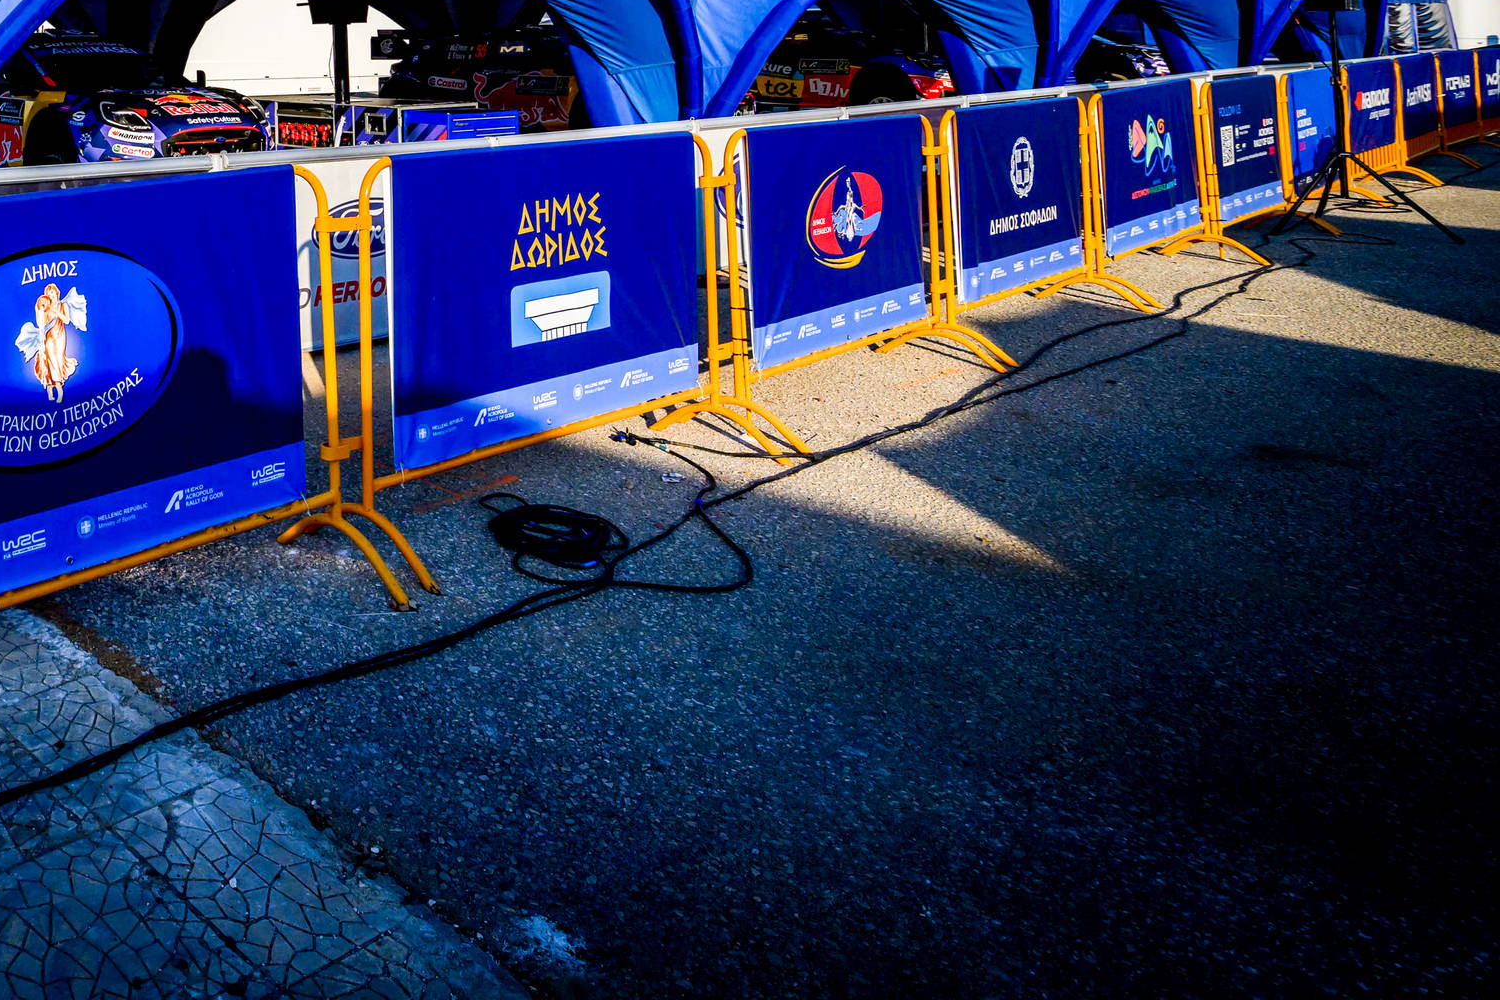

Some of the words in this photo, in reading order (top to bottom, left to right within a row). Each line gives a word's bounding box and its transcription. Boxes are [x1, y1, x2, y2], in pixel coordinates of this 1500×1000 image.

[436, 80, 466, 89] Castrol
[765, 81, 797, 98] tet
[161, 104, 203, 116] Red
[203, 102, 240, 114] Bull
[186, 116, 241, 125] SafetyCulture
[121, 146, 154, 157] Castrol
[518, 192, 602, 235] ΔΗΜΟΣ
[989, 214, 1019, 236] ΔΗΜΟΣ
[1020, 205, 1058, 229] ΣΟΦΑΔΩΝ
[510, 226, 608, 271] ΔΩΡΙΔΟΣ
[21, 260, 78, 285] ΔΗΜΟΣ
[63, 367, 144, 425] ΠΕΡΑΧΩΡΑΣ
[533, 390, 557, 405] WRC
[38, 404, 124, 450] ΘΕΟΔΩΡΩΝ
[251, 462, 285, 480] WRC
[185, 487, 214, 500] ACROPOLIS
[185, 498, 200, 508] RALLY
[209, 491, 224, 502] GODS
[97, 509, 122, 522] HELLENIC
[123, 502, 149, 515] REPUBLIC
[2, 529, 47, 552] WRC
